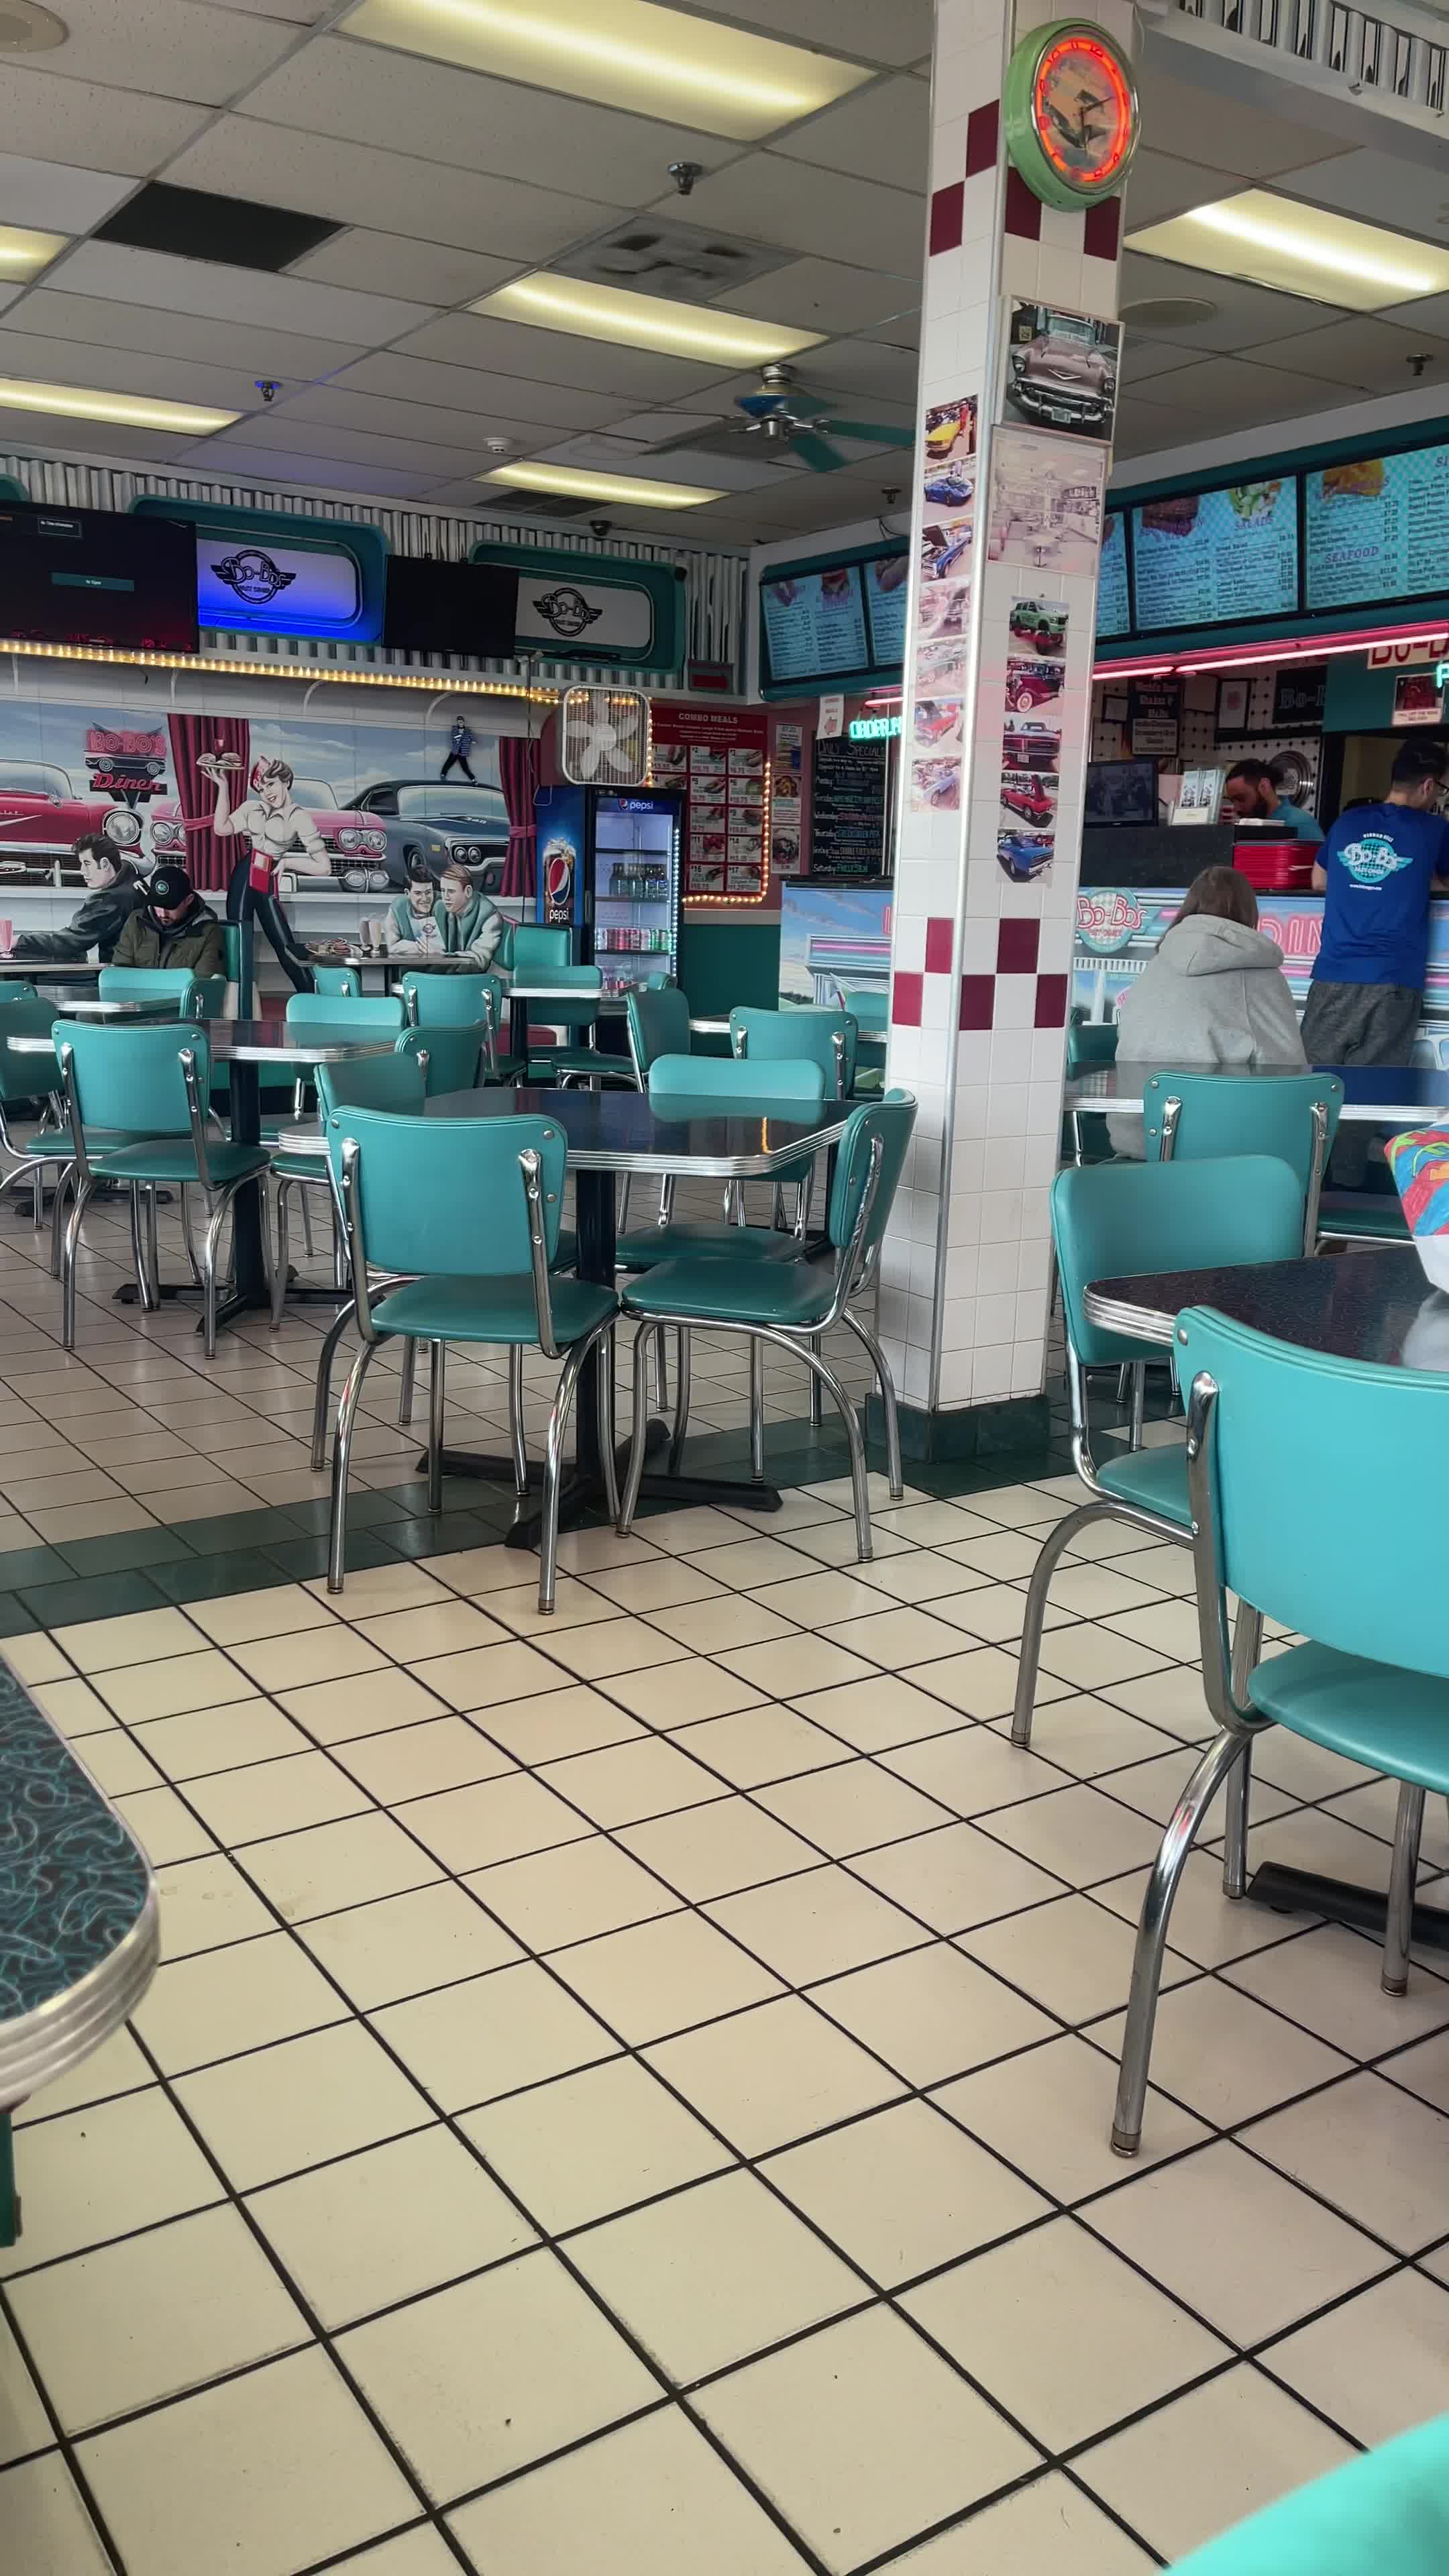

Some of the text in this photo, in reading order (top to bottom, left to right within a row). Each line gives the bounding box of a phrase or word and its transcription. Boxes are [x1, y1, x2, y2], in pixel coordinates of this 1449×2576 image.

[1325, 546, 1380, 564] SEAFOOD
[678, 712, 739, 724] COMBO MEALS
[90, 731, 165, 755] BO-BO'S
[92, 772, 162, 791] Diner
[629, 801, 654, 810] pepsi
[549, 908, 570, 923] pepsi
